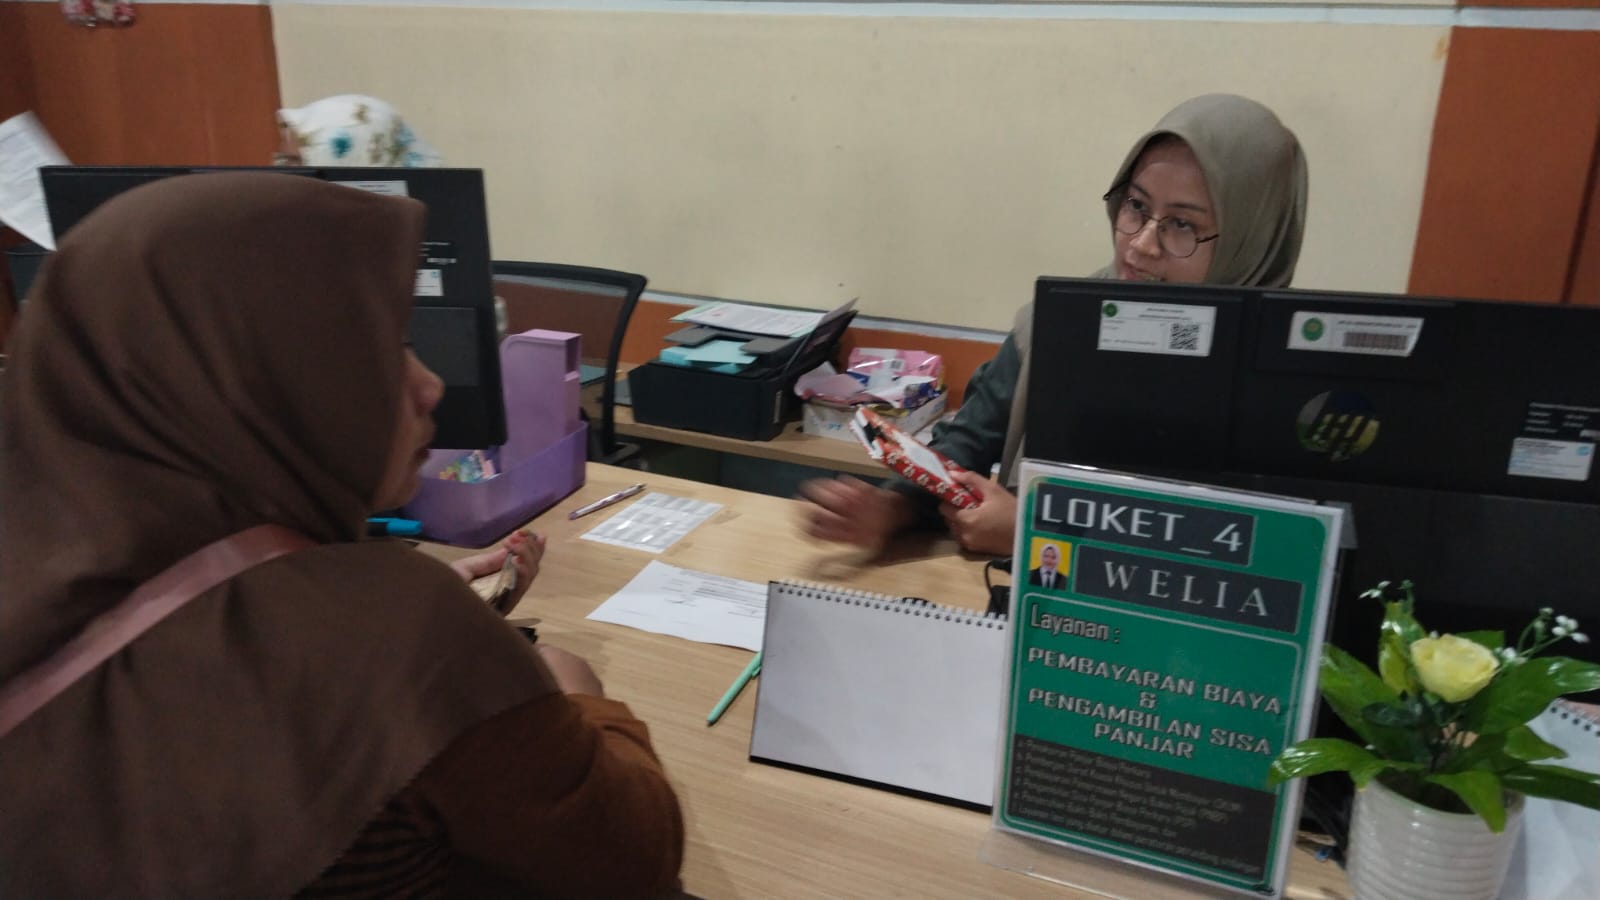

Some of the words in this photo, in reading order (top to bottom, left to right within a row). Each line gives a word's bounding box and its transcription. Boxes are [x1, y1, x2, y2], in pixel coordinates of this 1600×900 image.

[1041, 493, 1243, 555] LOKET_4
[1103, 561, 1270, 617] WELIA
[1030, 603, 1109, 641] Layanan
[1028, 646, 1196, 696] PEMBAYARAN
[1203, 683, 1282, 715] BIAYA
[1138, 691, 1158, 709] &
[1028, 687, 1202, 740] PENGAMBILAN
[1209, 727, 1272, 756] SISA
[1093, 722, 1195, 760] PANJAR
